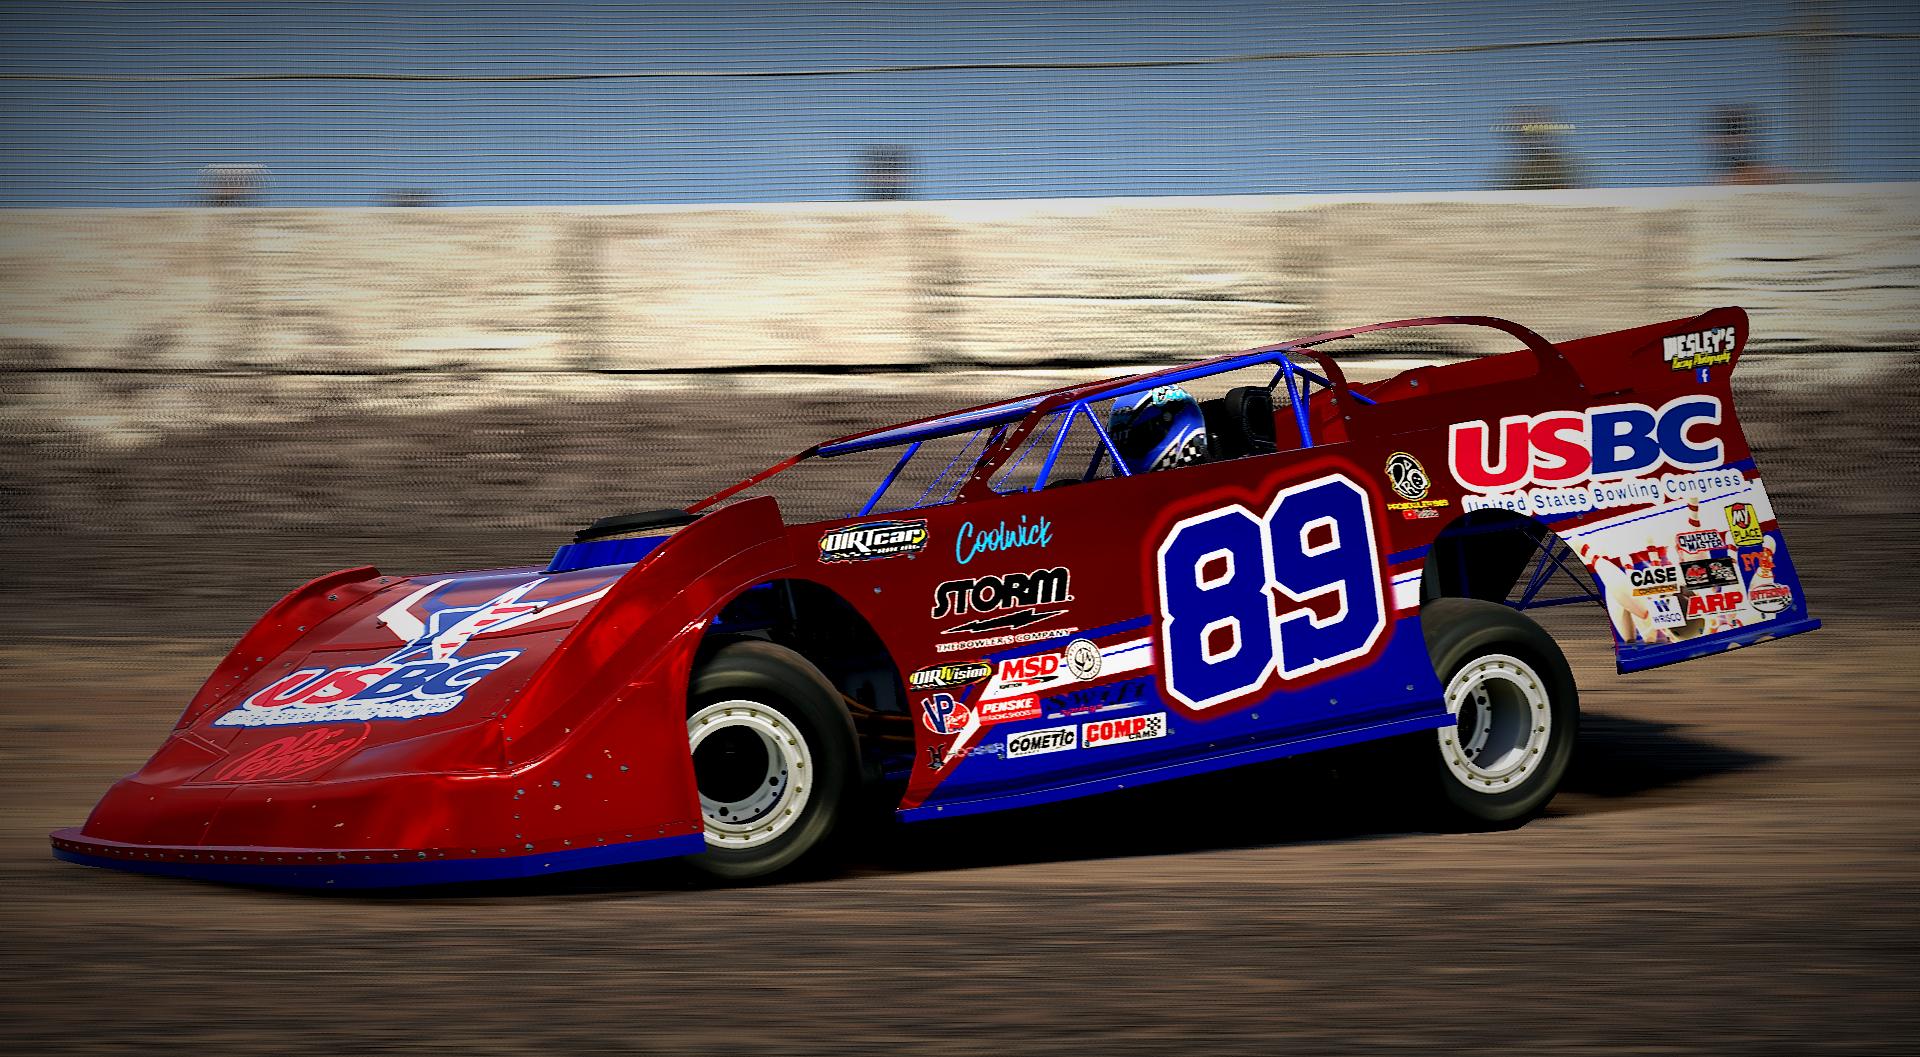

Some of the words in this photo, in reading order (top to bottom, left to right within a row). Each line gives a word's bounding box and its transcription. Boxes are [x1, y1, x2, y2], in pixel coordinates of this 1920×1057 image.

[1452, 396, 1721, 491] USBC
[1534, 493, 1587, 509] States
[1594, 481, 1659, 504] Bowling
[1666, 476, 1741, 496] Congress
[1732, 506, 1751, 526] MY
[956, 516, 1053, 564] Coolwick
[1733, 528, 1760, 539] PLACE
[1631, 567, 1677, 586] CASE
[1157, 473, 1386, 710] 89
[1688, 592, 1743, 615] ARP
[1016, 629, 1069, 642] COMPANY
[1001, 655, 1058, 680] MSD
[243, 651, 521, 710] USBC
[921, 694, 954, 734] VP
[982, 698, 1034, 714] PENSKE
[1009, 730, 1075, 753] COMETIC
[1087, 718, 1145, 742] COMP
[1129, 730, 1158, 740] CAMS
